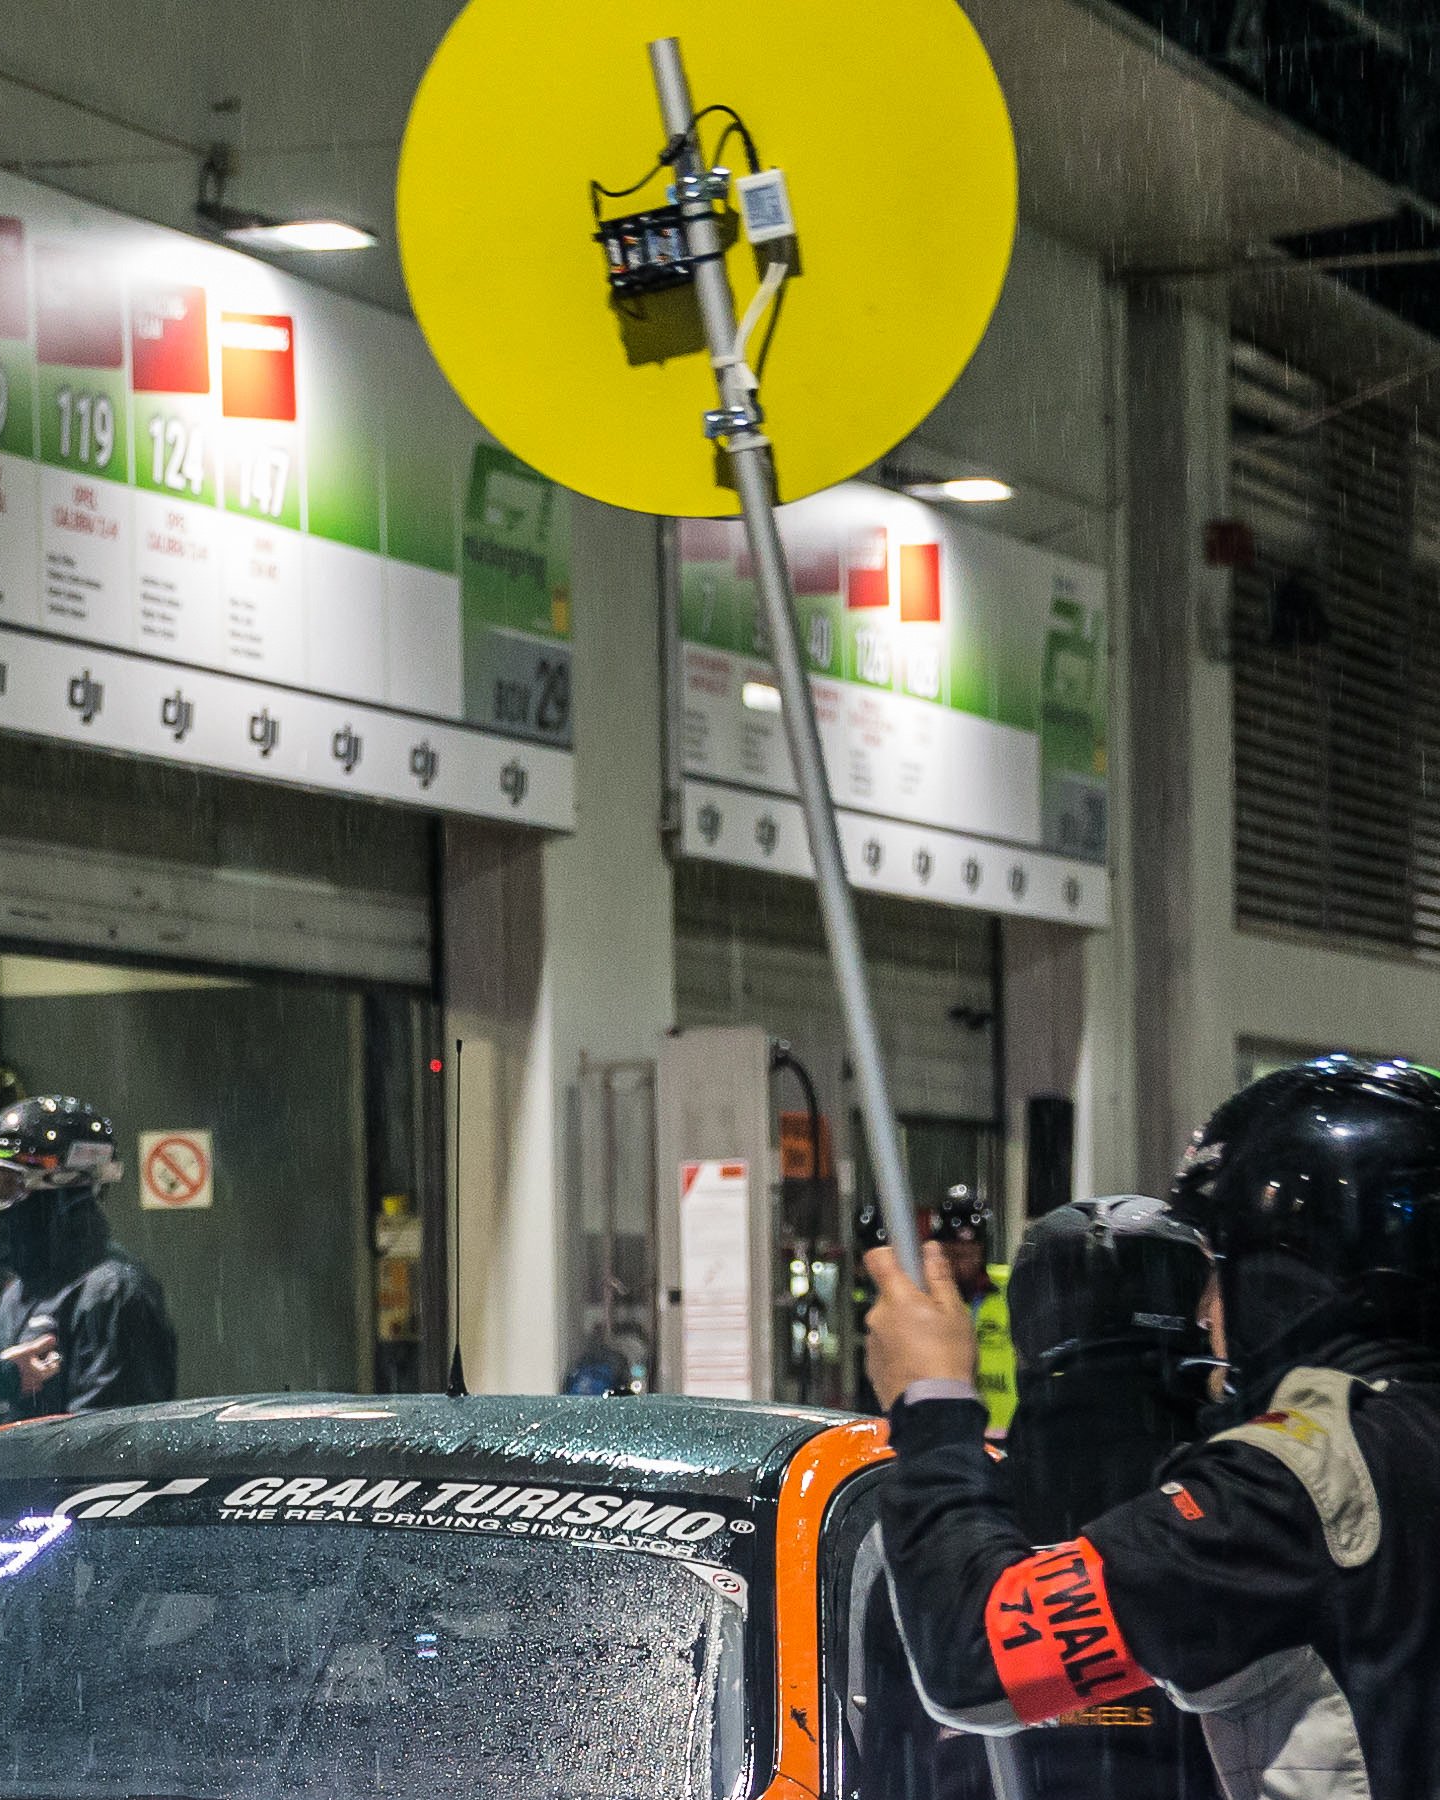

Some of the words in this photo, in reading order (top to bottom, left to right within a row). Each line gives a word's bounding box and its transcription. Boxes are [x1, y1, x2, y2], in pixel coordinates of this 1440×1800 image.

[56, 385, 115, 467] 119
[148, 415, 206, 496] 124
[218, 1508, 278, 1521] THE
[284, 1509, 365, 1523] REAL
[372, 1511, 502, 1532] DRIVING
[506, 1521, 699, 1558] SIMULATOR
[222, 1476, 422, 1509] GRAN
[420, 1482, 728, 1543] TURISMO
